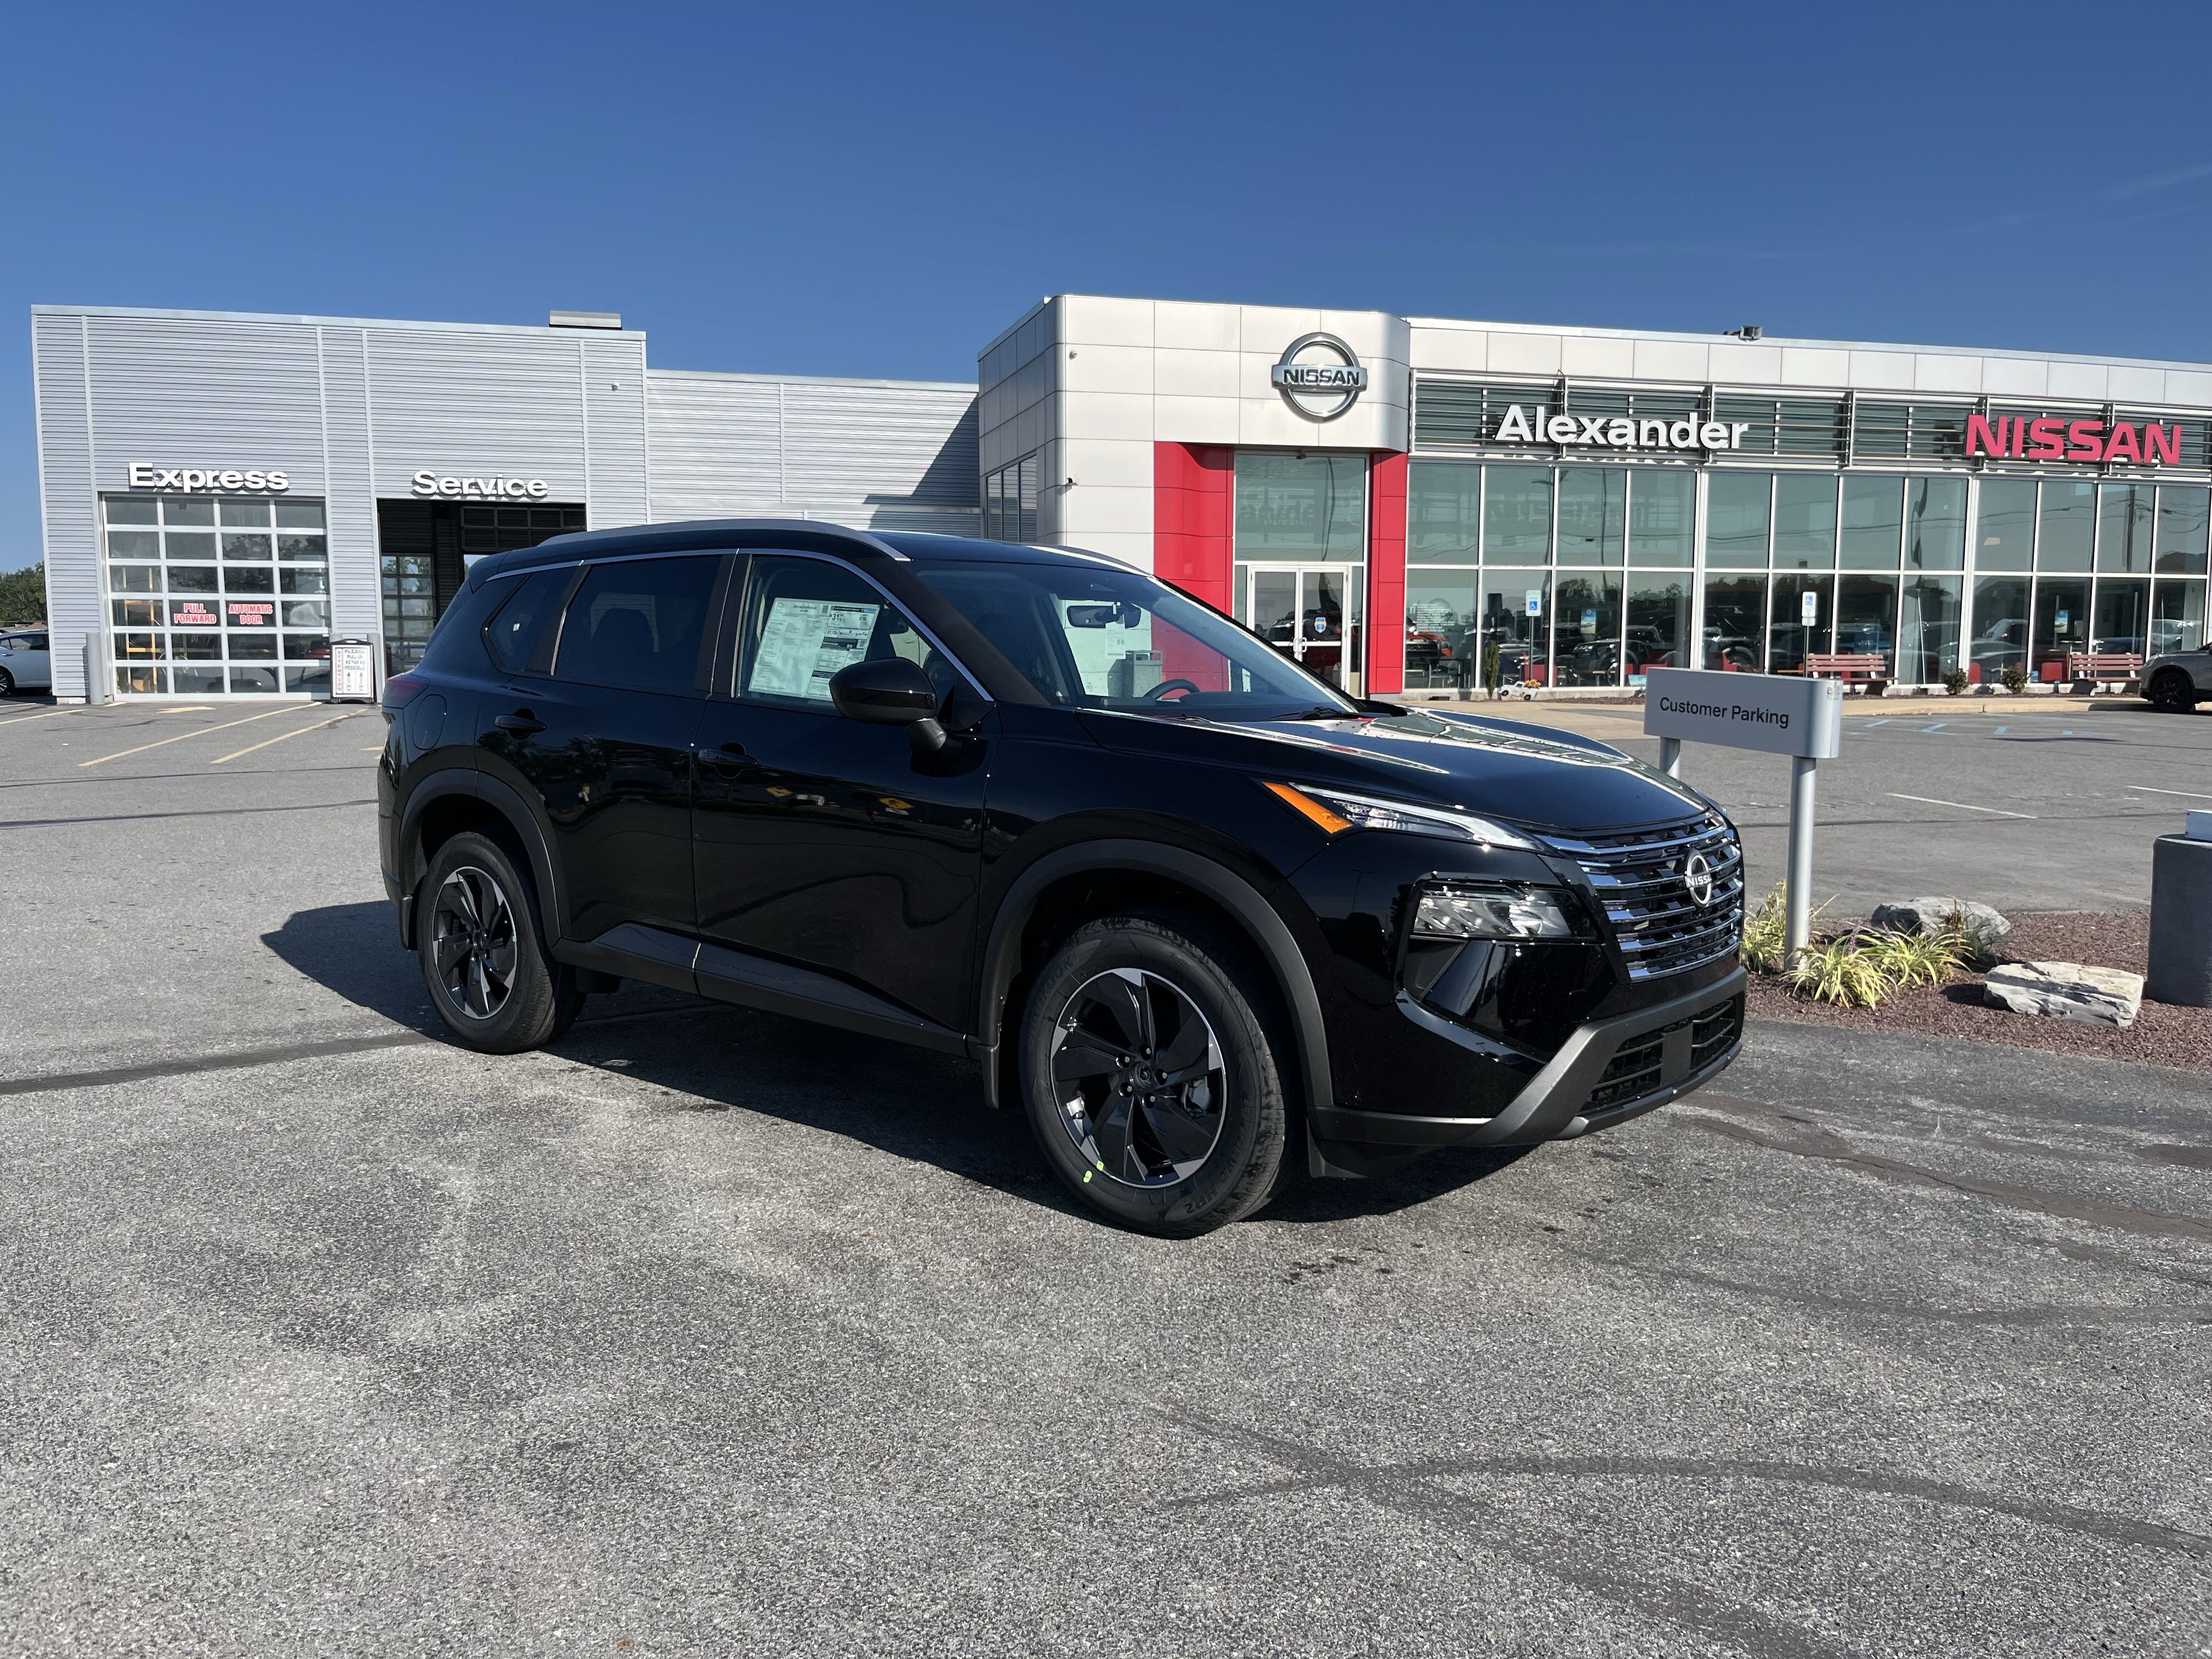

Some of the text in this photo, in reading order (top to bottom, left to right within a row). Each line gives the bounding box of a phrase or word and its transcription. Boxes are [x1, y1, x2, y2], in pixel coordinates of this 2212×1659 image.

[1282, 369, 1360, 386] NISSAN
[1494, 404, 2182, 465] Alexander NISSAN
[129, 462, 290, 493] Express
[413, 470, 549, 496] Service
[184, 603, 207, 613] PULL
[229, 604, 273, 614] AUTOMATIC
[174, 613, 217, 624] FORWARD
[240, 614, 263, 624] DOOR
[1659, 696, 1789, 729] Customer Parking
